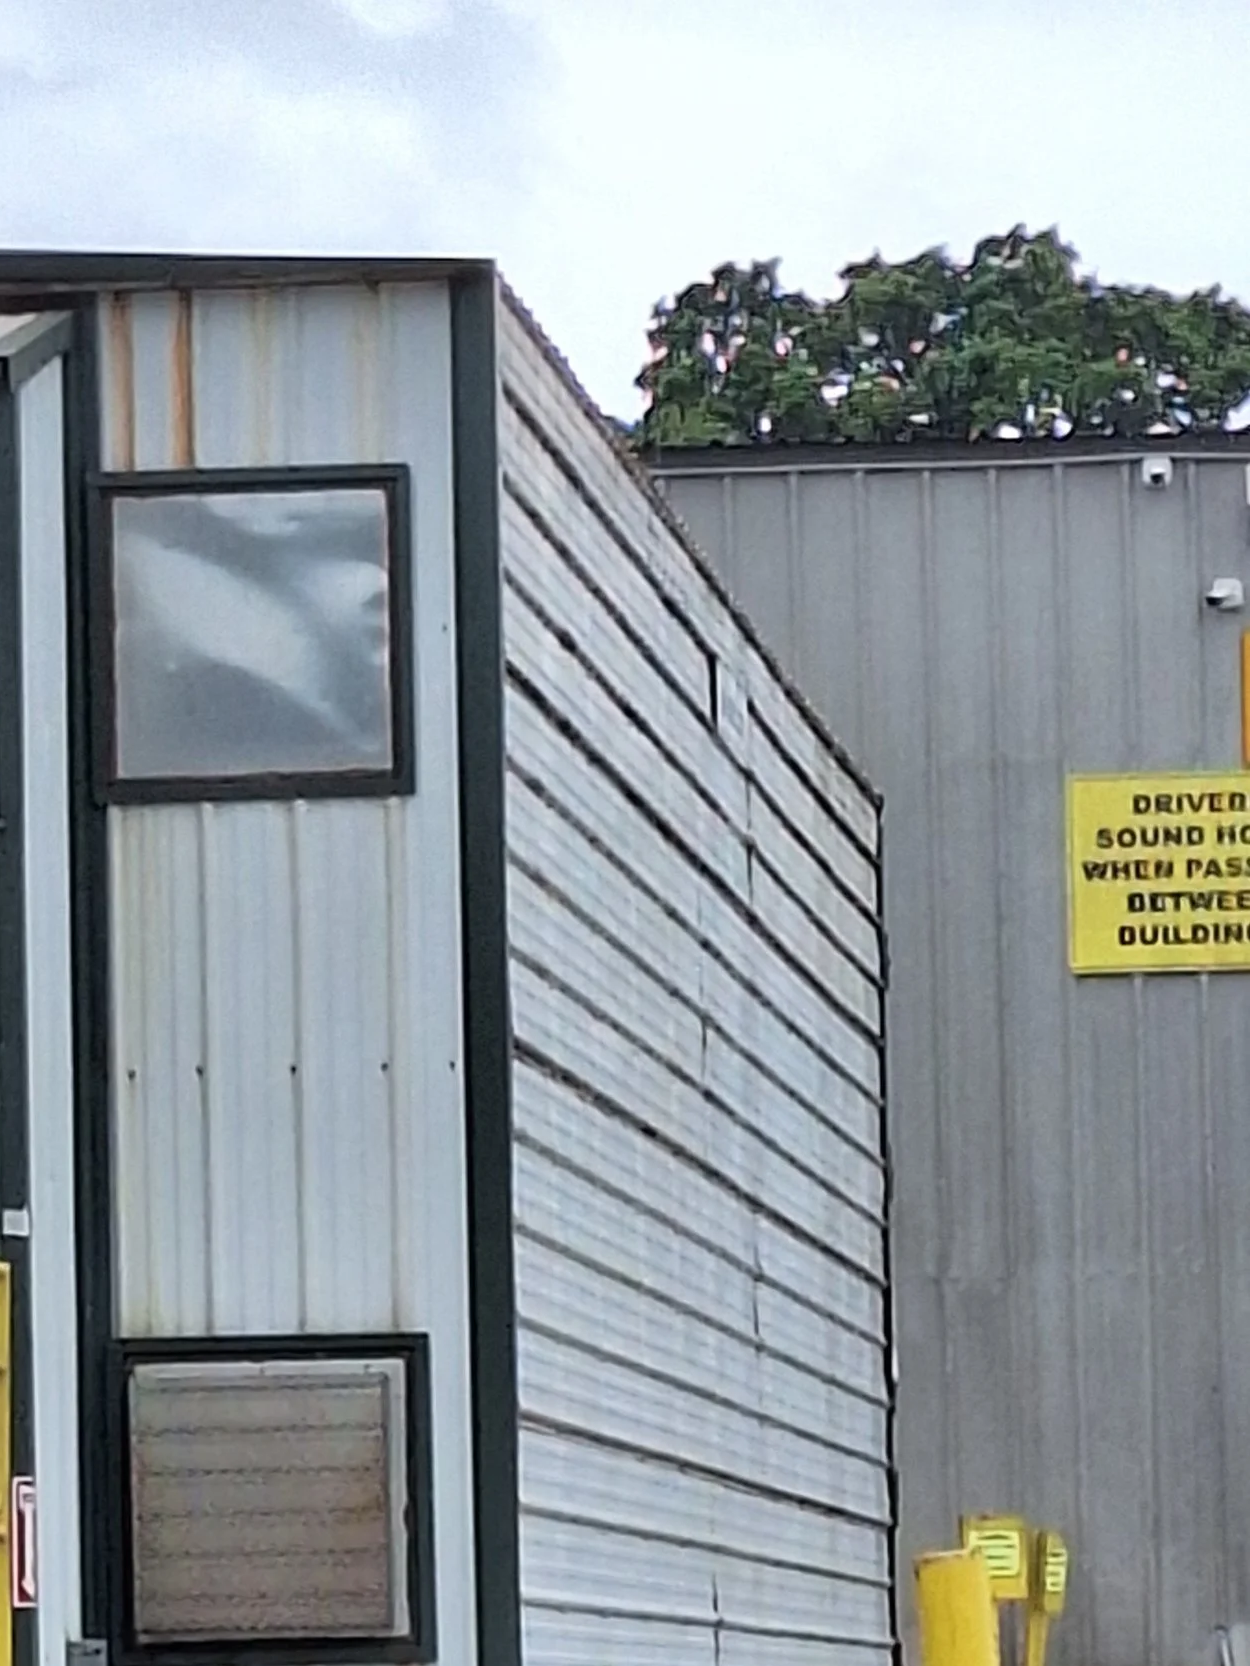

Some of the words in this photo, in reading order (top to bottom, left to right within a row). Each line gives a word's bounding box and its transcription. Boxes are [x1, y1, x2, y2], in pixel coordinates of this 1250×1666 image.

[1096, 826, 1205, 849] SOUND
[1082, 859, 1175, 881] WHEN
[1186, 857, 1250, 880] PAS
[1118, 922, 1250, 946] BUILDIN
